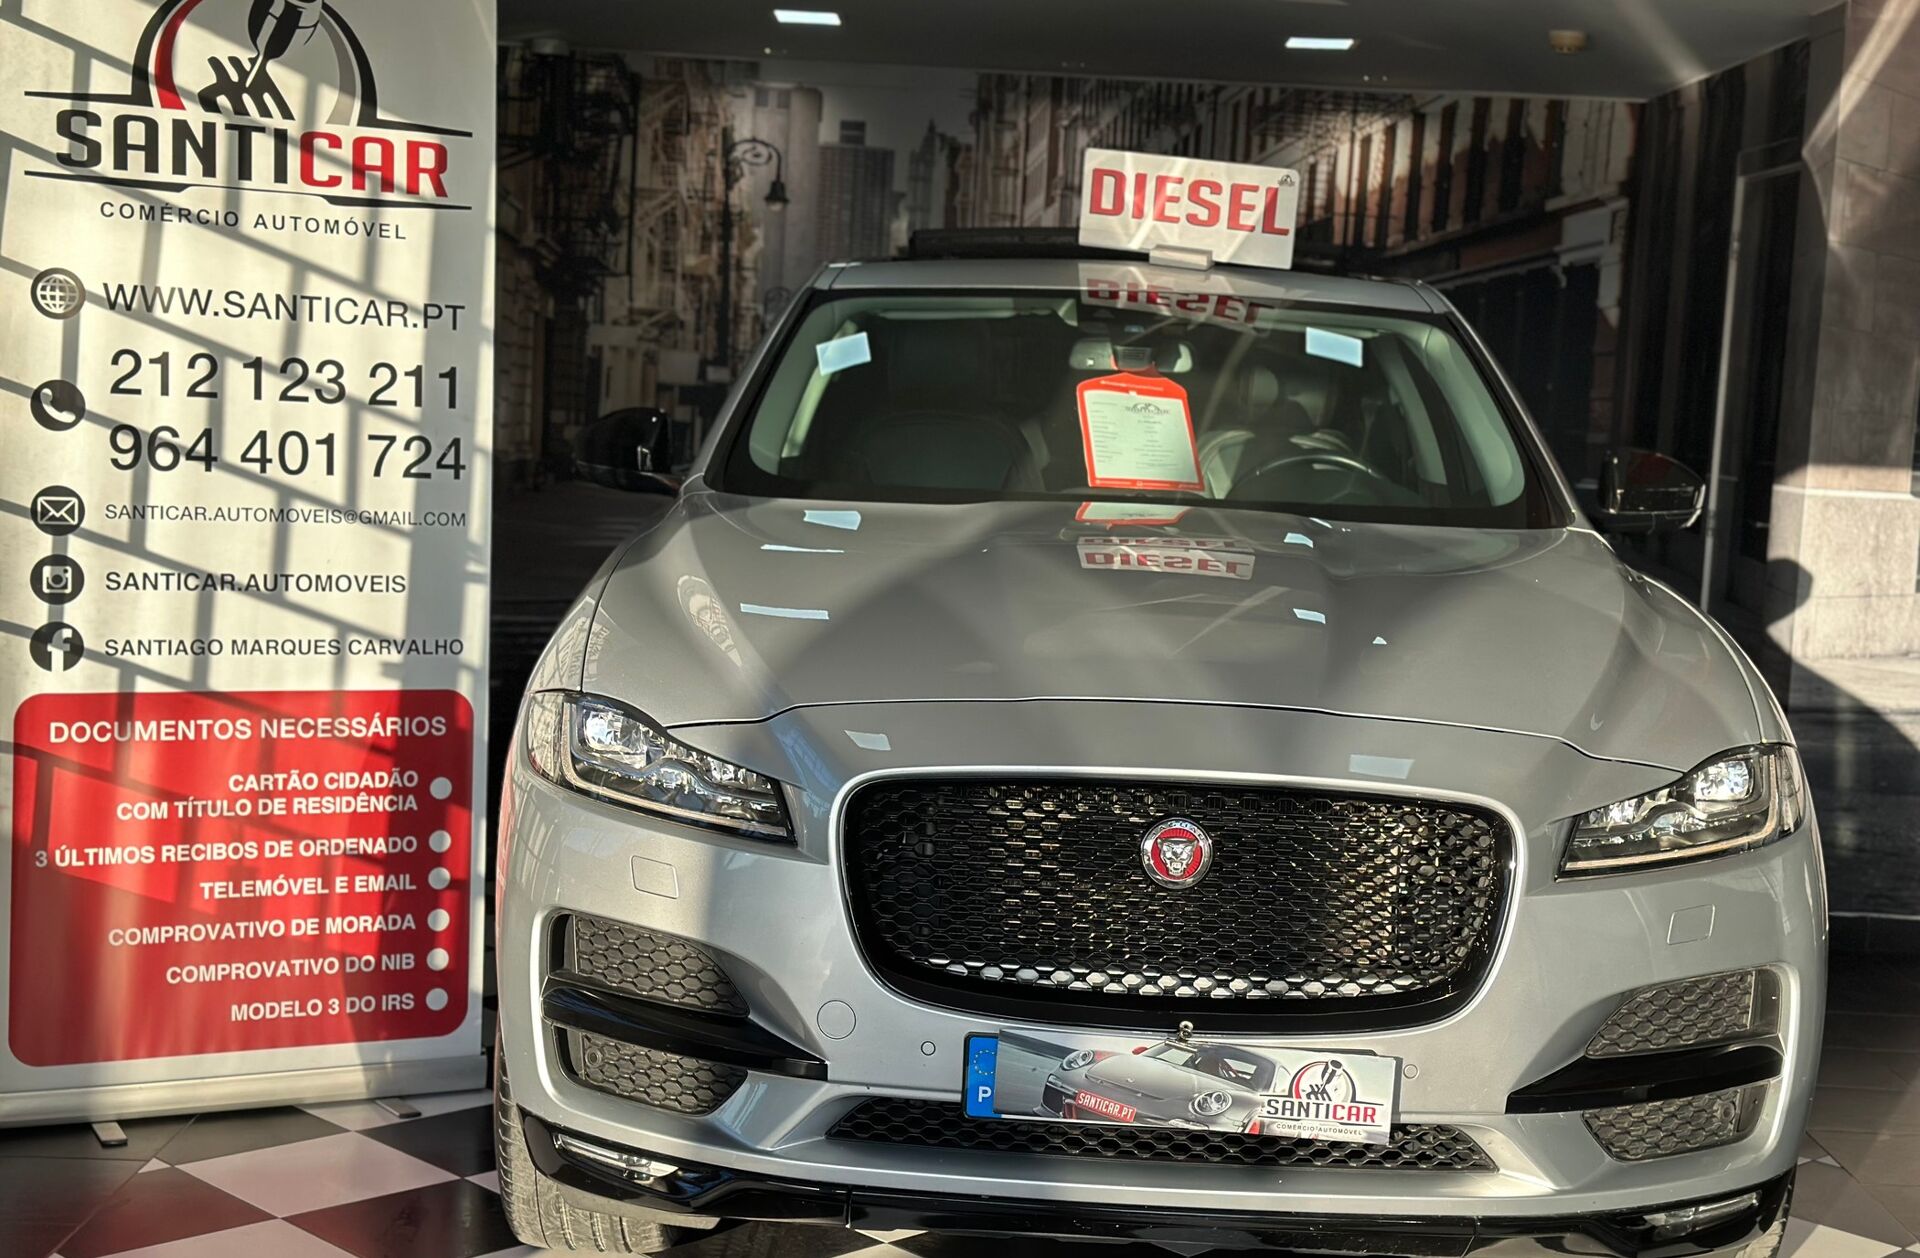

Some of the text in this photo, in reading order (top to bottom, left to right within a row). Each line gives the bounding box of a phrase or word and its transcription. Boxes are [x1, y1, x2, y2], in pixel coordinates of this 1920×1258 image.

[56, 109, 449, 198] SANTICAR
[1089, 167, 1290, 236] DIESEL
[100, 201, 407, 240] COMÉRCIO AUTOMÓVEL
[103, 282, 465, 331] WWW.SANTICAR.PT
[109, 348, 458, 410] 212 123 211
[109, 424, 467, 480] 964 401 724
[105, 503, 467, 529] SANTICAR.AUTOMOVEIS@GMAIL.COM
[105, 571, 407, 594] SANTICAR.AUTOMOVEIS
[105, 638, 465, 657] SANTIAGO MARQUES CARVALHO
[48, 711, 447, 744] DOCUMENTOS NECESSÁRIOS
[228, 766, 419, 793] CARTÃO CIDADÃO
[116, 792, 418, 821] COM TÍTULO DE RESIDÊNCIA
[35, 835, 418, 868] 3 ÚLTIMOS RECIBOS DE ORDENADO
[200, 872, 417, 900] TELEMÓVEL E EMAIL
[108, 913, 416, 947] COMPROVATIVO DE MORADA
[166, 952, 416, 985] COMPROVATIVO DO NIB
[231, 993, 415, 1022] MODELO 3 DO IRS
[977, 1086, 992, 1103] P
[1078, 1092, 1134, 1122] SANTICAR.PT
[1266, 1098, 1377, 1124] SANTICAR
